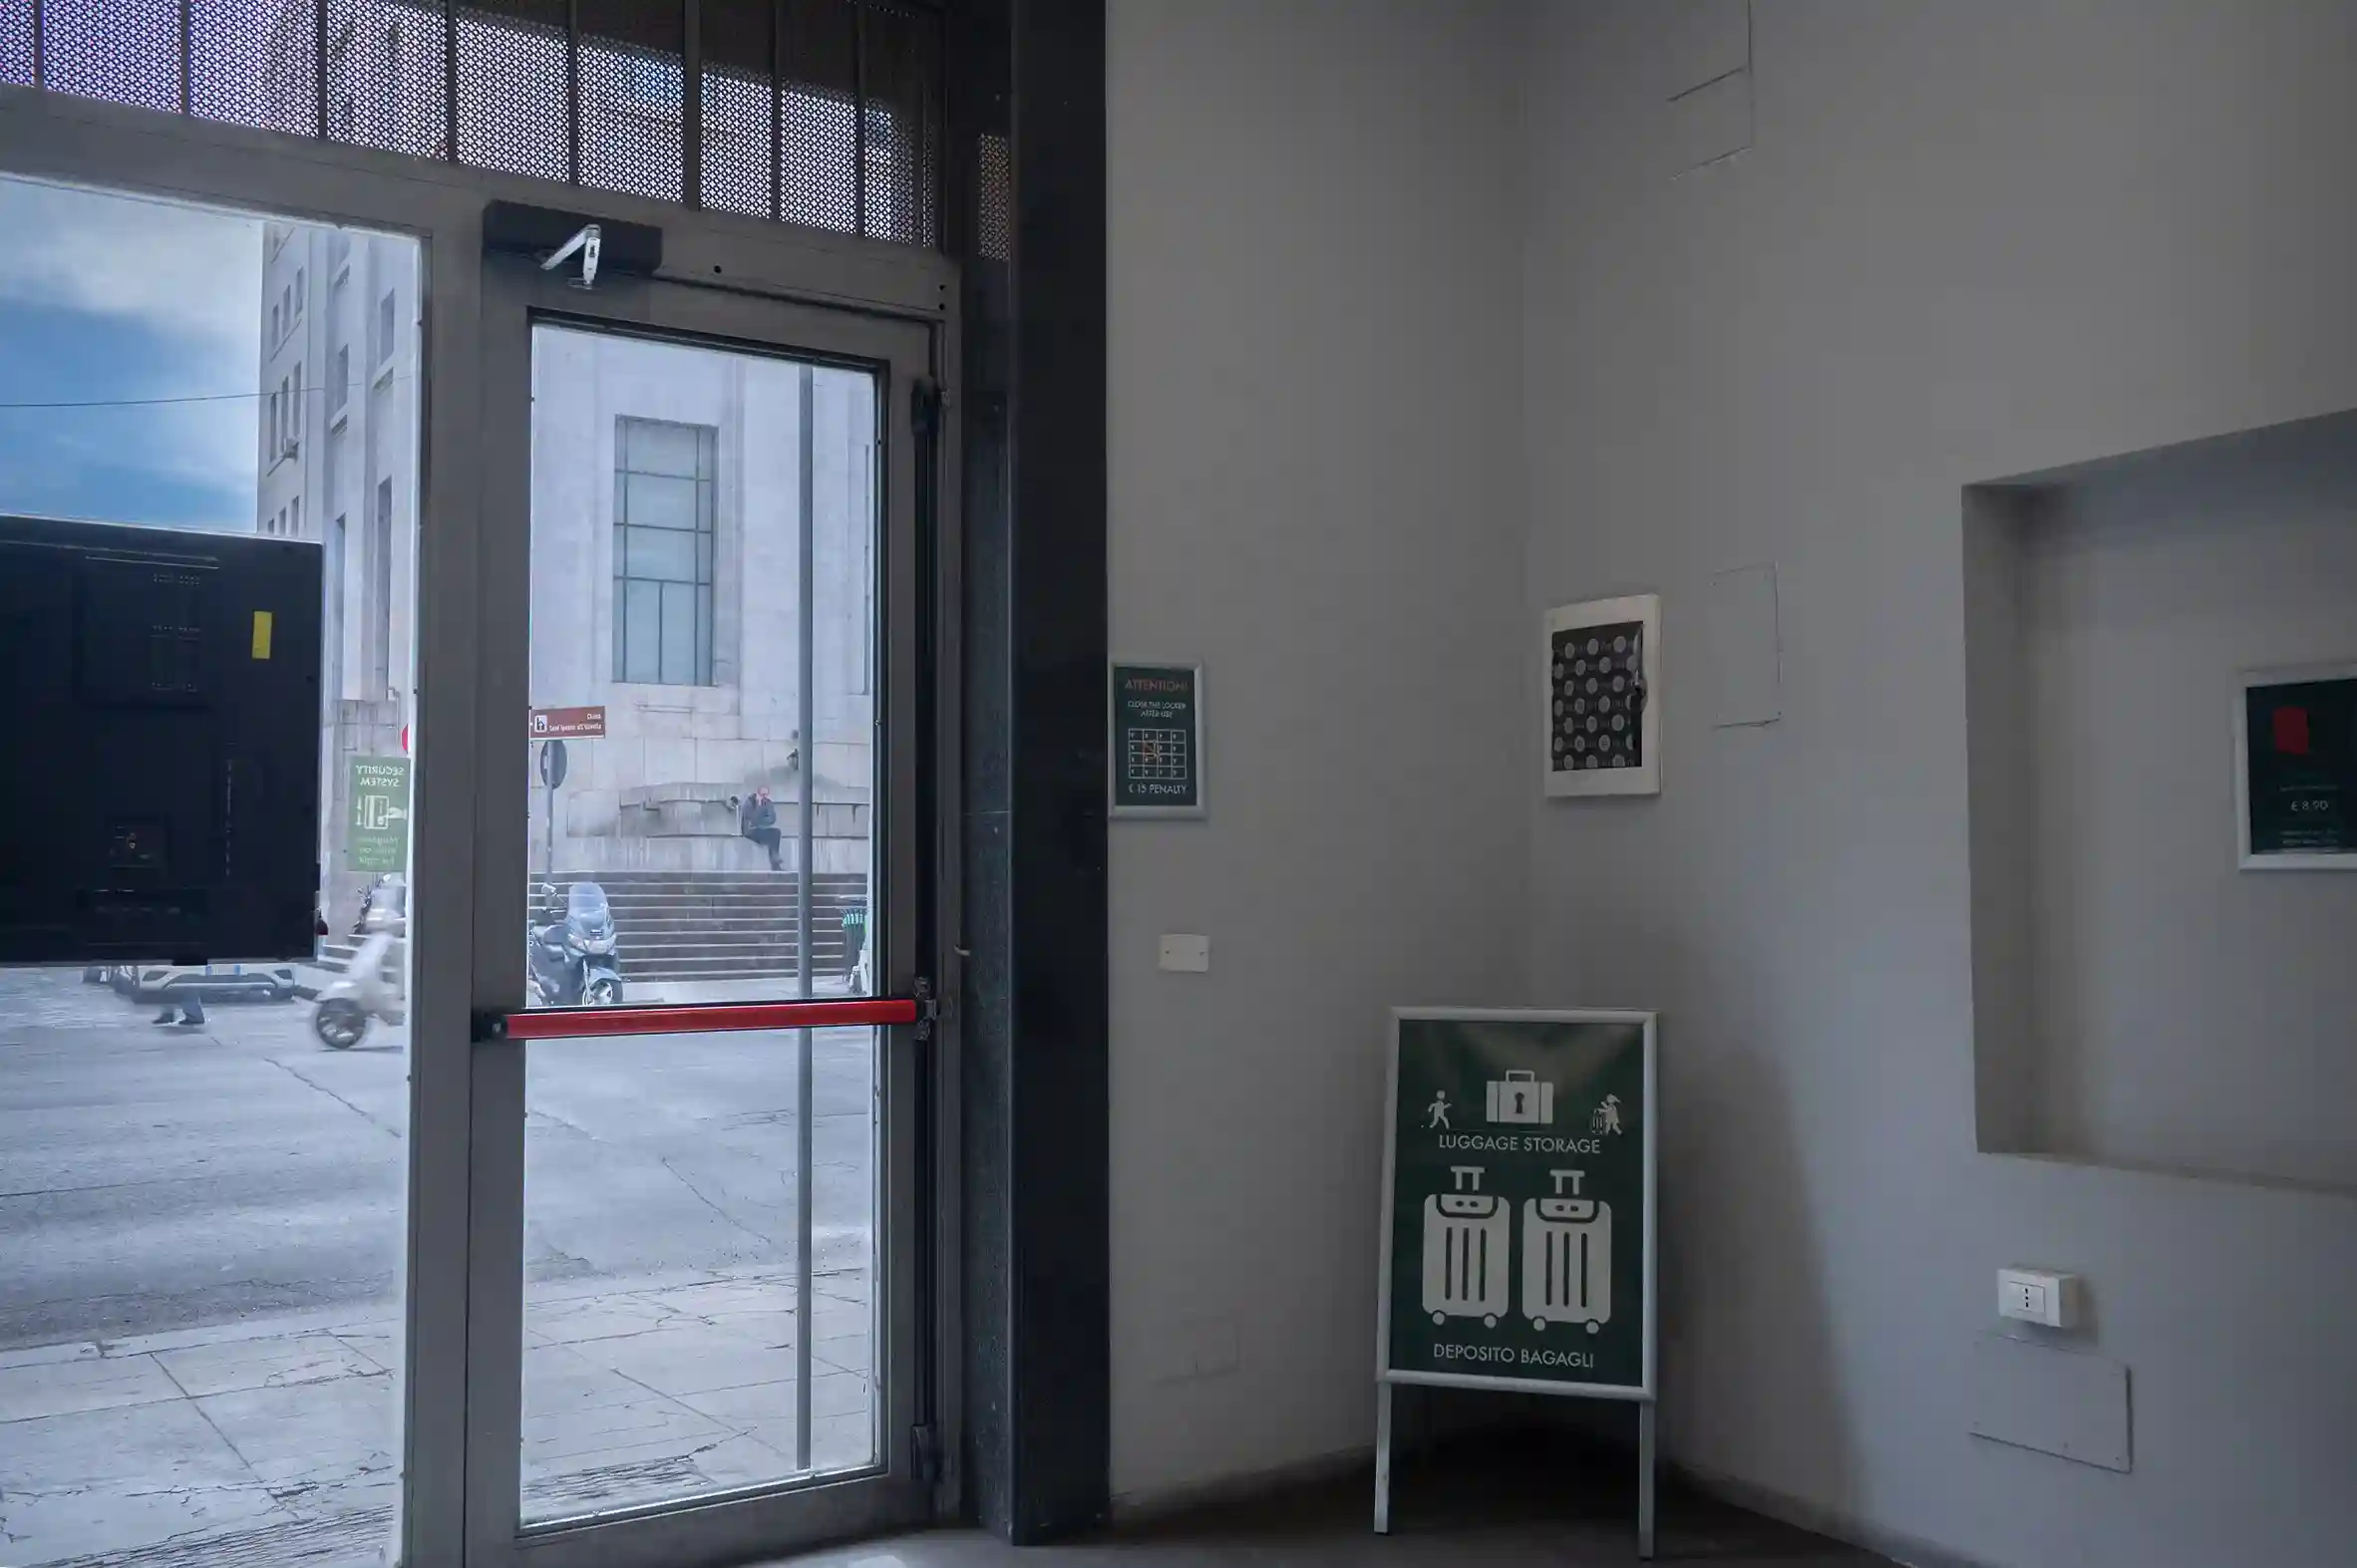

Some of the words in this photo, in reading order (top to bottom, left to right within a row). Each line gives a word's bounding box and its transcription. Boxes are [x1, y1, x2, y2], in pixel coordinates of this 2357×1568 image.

[1125, 679, 1188, 693] ATTENTION!
[1149, 784, 1187, 794] PENALTY
[1439, 1134, 1518, 1151] LUGGAGE
[1523, 1136, 1601, 1154] STORAGE
[1433, 1343, 1515, 1364] DEPOSITO
[1520, 1349, 1595, 1370] BAGAGLI
